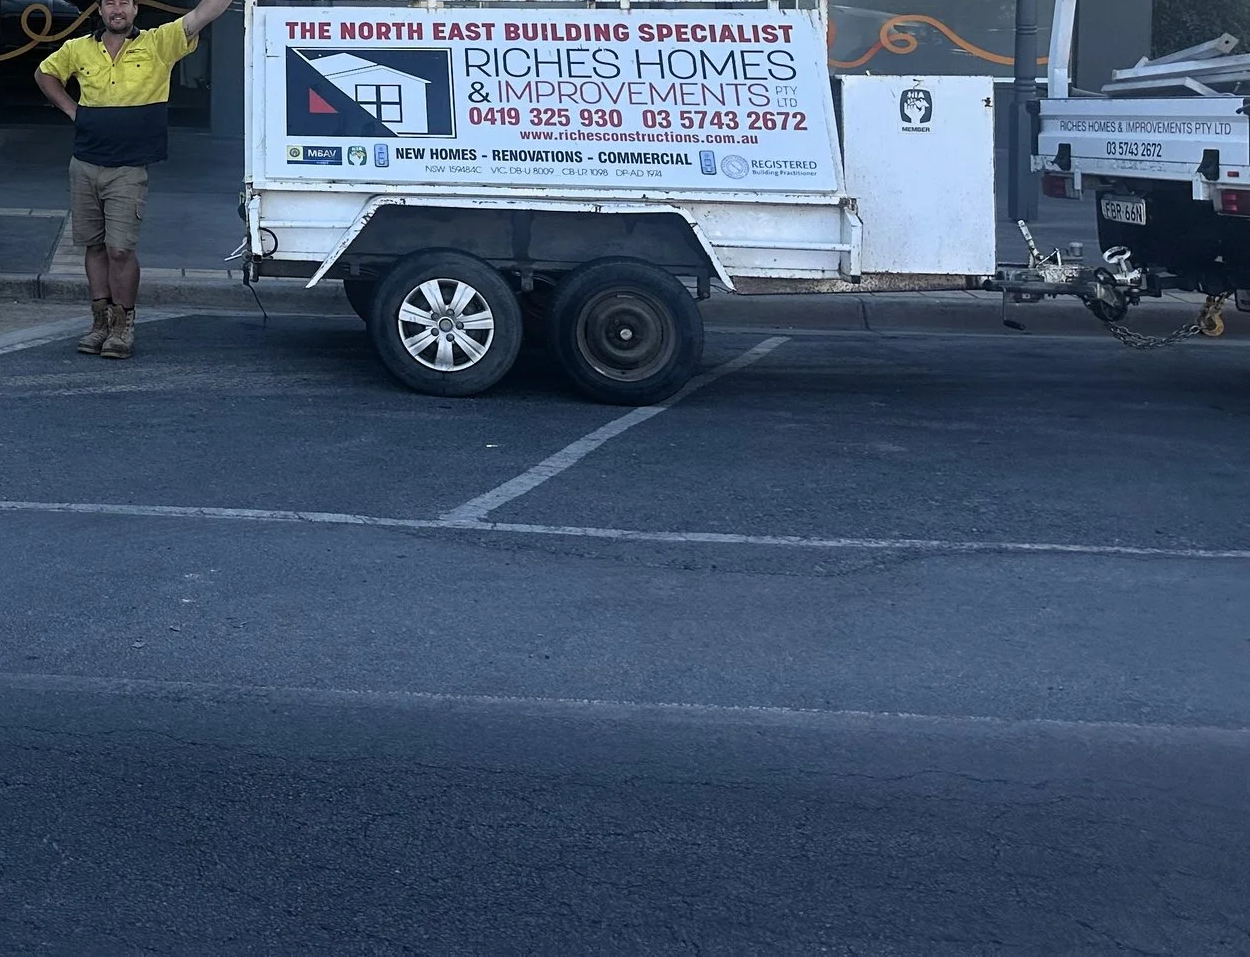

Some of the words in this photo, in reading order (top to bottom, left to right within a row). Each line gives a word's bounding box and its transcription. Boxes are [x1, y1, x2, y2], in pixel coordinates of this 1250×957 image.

[286, 21, 332, 40] THE
[340, 22, 423, 41] NORTH
[432, 23, 496, 41] EAST
[504, 23, 630, 42] BUILDING
[638, 24, 793, 44] SPECIALIST
[464, 47, 621, 79] RICHES
[635, 49, 797, 81] HOMES
[468, 81, 492, 104] &
[498, 80, 771, 107] IMPROVEMENTS
[775, 85, 798, 95] PTY
[777, 97, 798, 108] LTD
[469, 106, 520, 126] 0419
[529, 107, 571, 127] 325
[579, 108, 622, 128] 930
[642, 109, 672, 129] 03
[679, 110, 739, 130] 5743
[748, 111, 808, 131] 2672
[1060, 120, 1087, 132] RICHES
[1088, 121, 1116, 132] HOMES
[1117, 122, 1123, 132] &
[1126, 122, 1193, 134] IMPROVEMENTS
[1195, 122, 1212, 135] PTY
[1215, 123, 1231, 135] LTD
[520, 129, 758, 145] www.richesconstructions.com.au
[307, 149, 337, 158] MBAV
[396, 148, 425, 160] NEW
[430, 148, 477, 161] HOMES
[492, 149, 583, 163] RENOVATIONS
[599, 151, 692, 165] COMMERCIAL
[1106, 142, 1116, 156] 03
[1118, 142, 1139, 157] 5743
[1141, 143, 1162, 158] 2672
[425, 165, 446, 173] NSW
[533, 167, 554, 175] 8009
[590, 168, 609, 176] 1098
[751, 160, 817, 170] REGISTERED
[752, 169, 779, 177] Building
